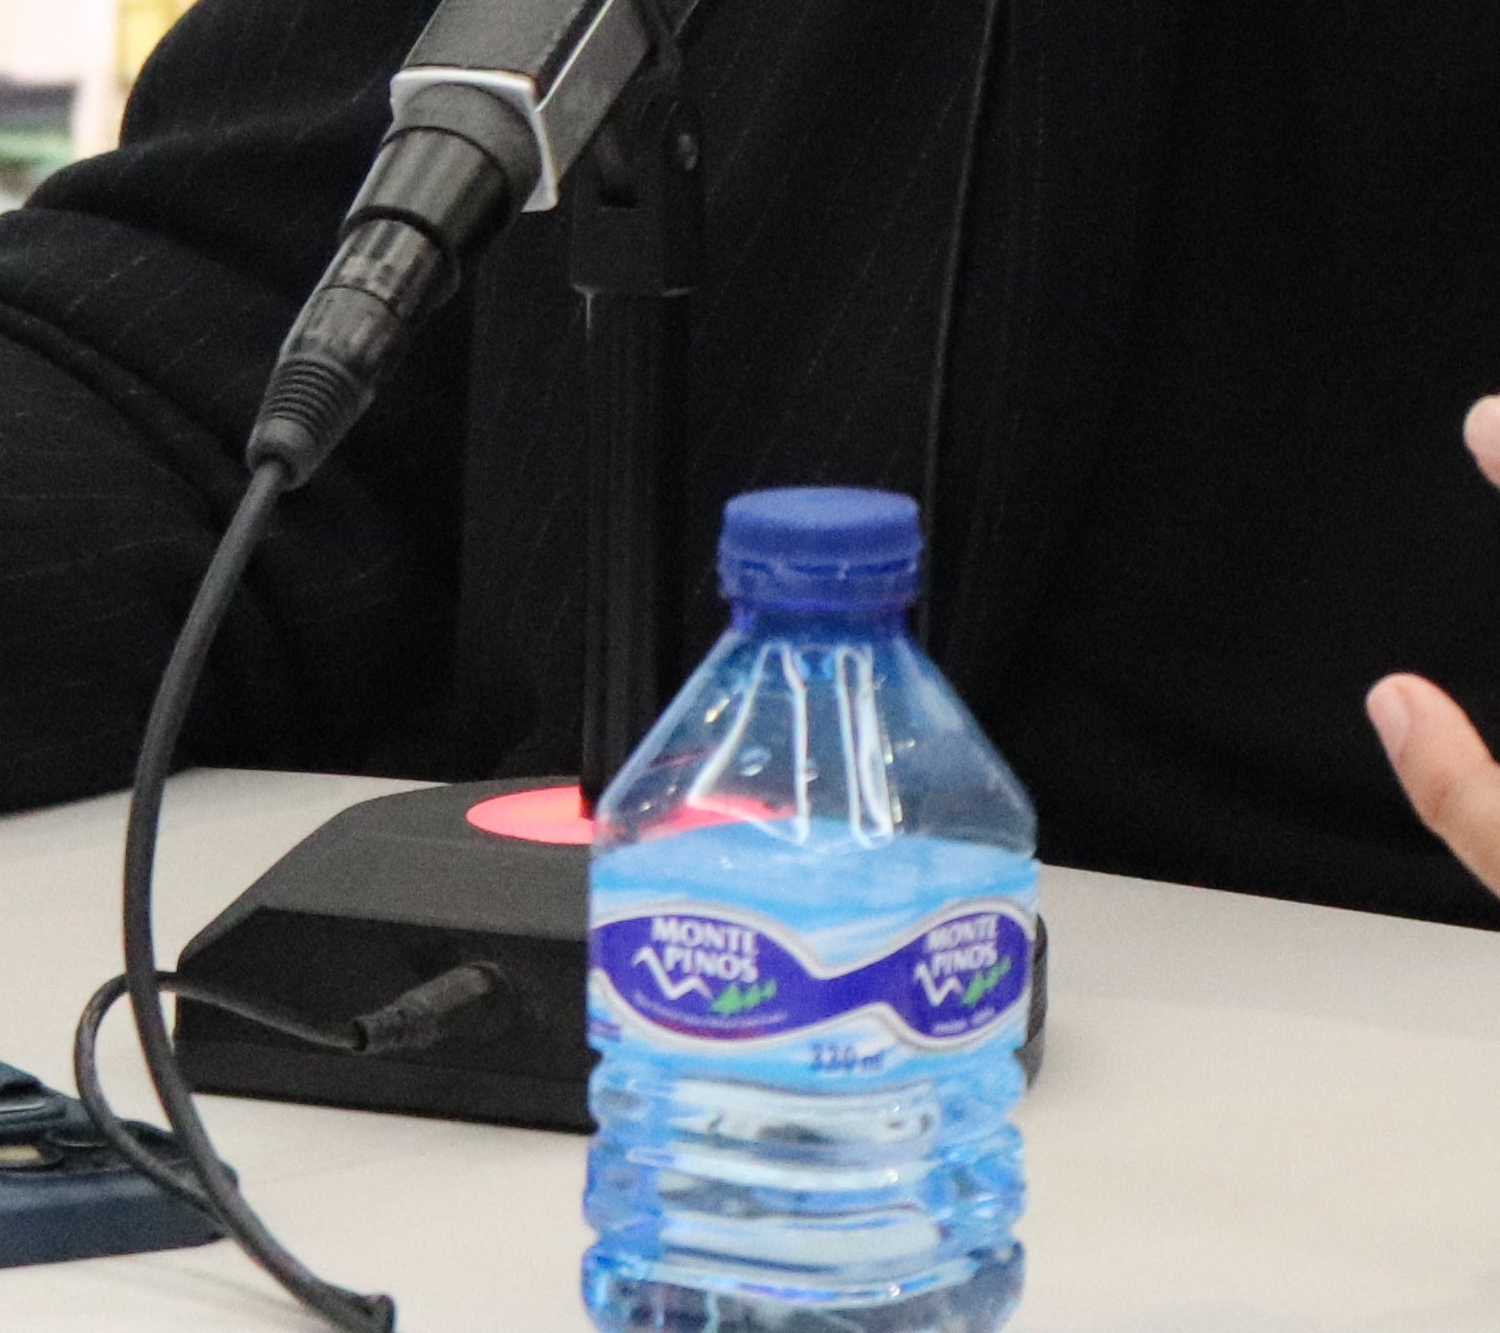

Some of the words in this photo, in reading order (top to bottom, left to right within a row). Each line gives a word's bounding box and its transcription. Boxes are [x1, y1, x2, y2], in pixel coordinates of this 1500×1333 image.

[652, 916, 759, 957] MONTE
[925, 914, 999, 953] MONTE
[663, 945, 759, 984] PINOS
[930, 941, 999, 979] PINOS
